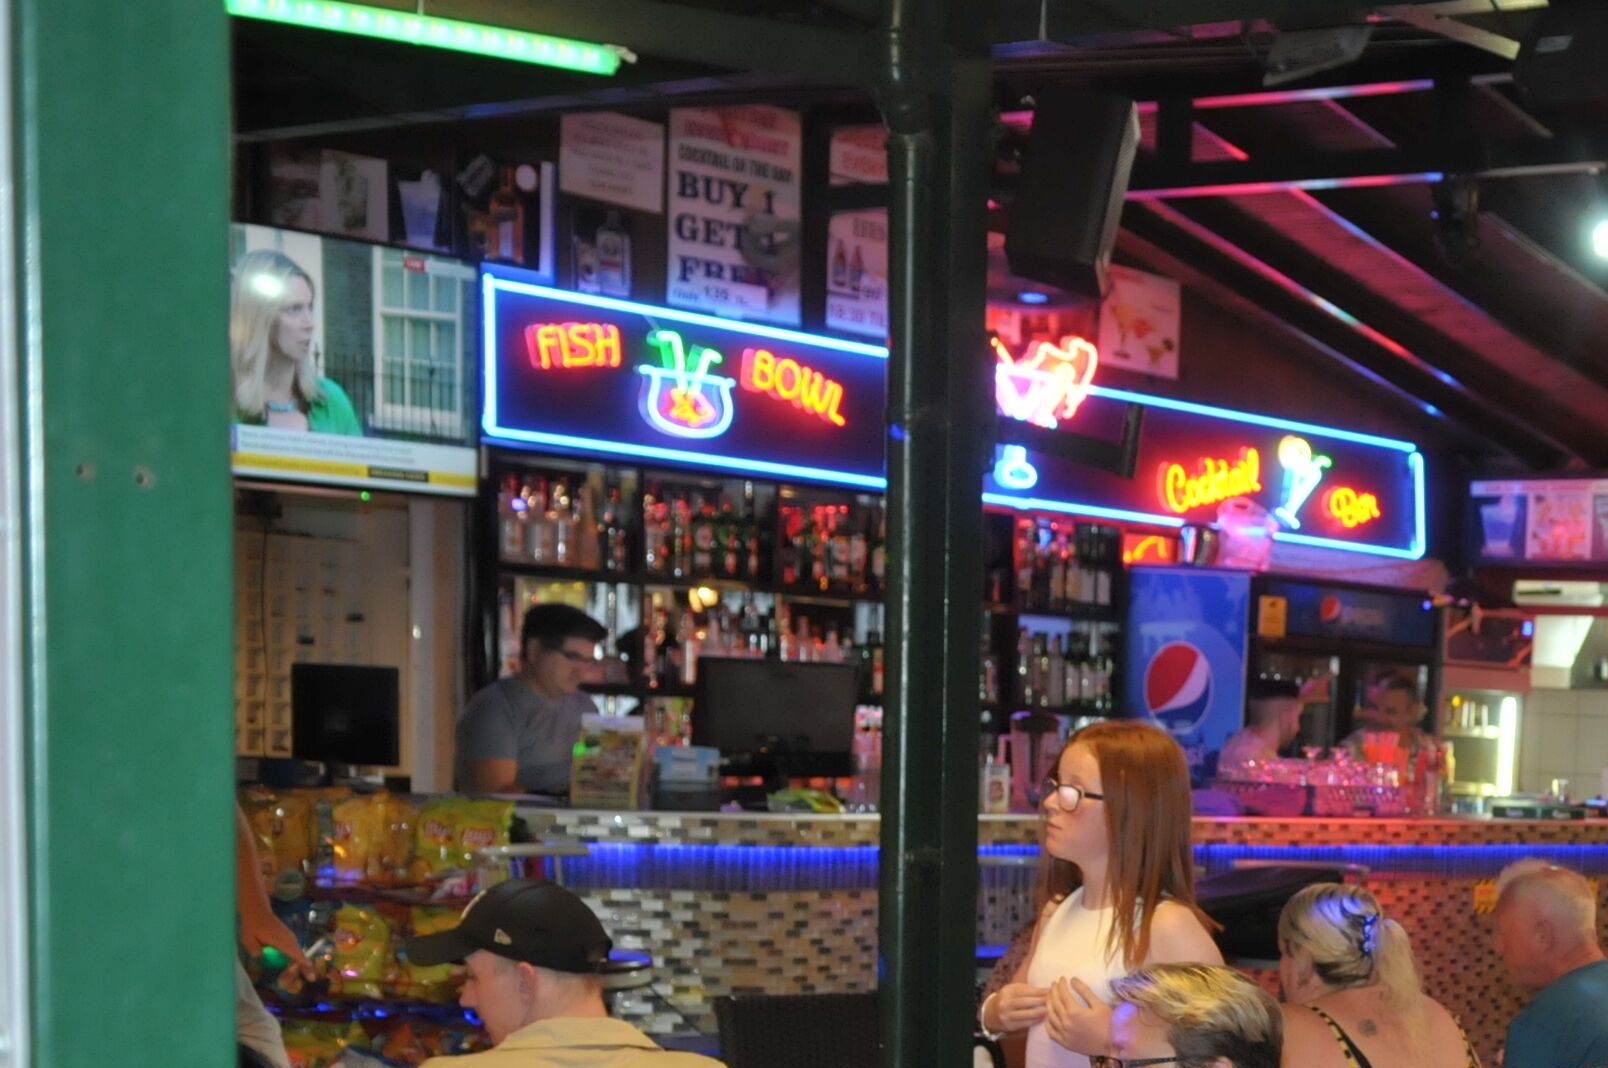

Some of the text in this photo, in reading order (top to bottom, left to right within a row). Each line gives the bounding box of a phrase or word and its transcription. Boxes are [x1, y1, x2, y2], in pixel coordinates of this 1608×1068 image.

[676, 170, 748, 209] BUY
[674, 212, 749, 250] GET
[534, 323, 621, 370] FISH
[751, 349, 846, 427] BOWL
[1165, 447, 1262, 514] Cocktail
